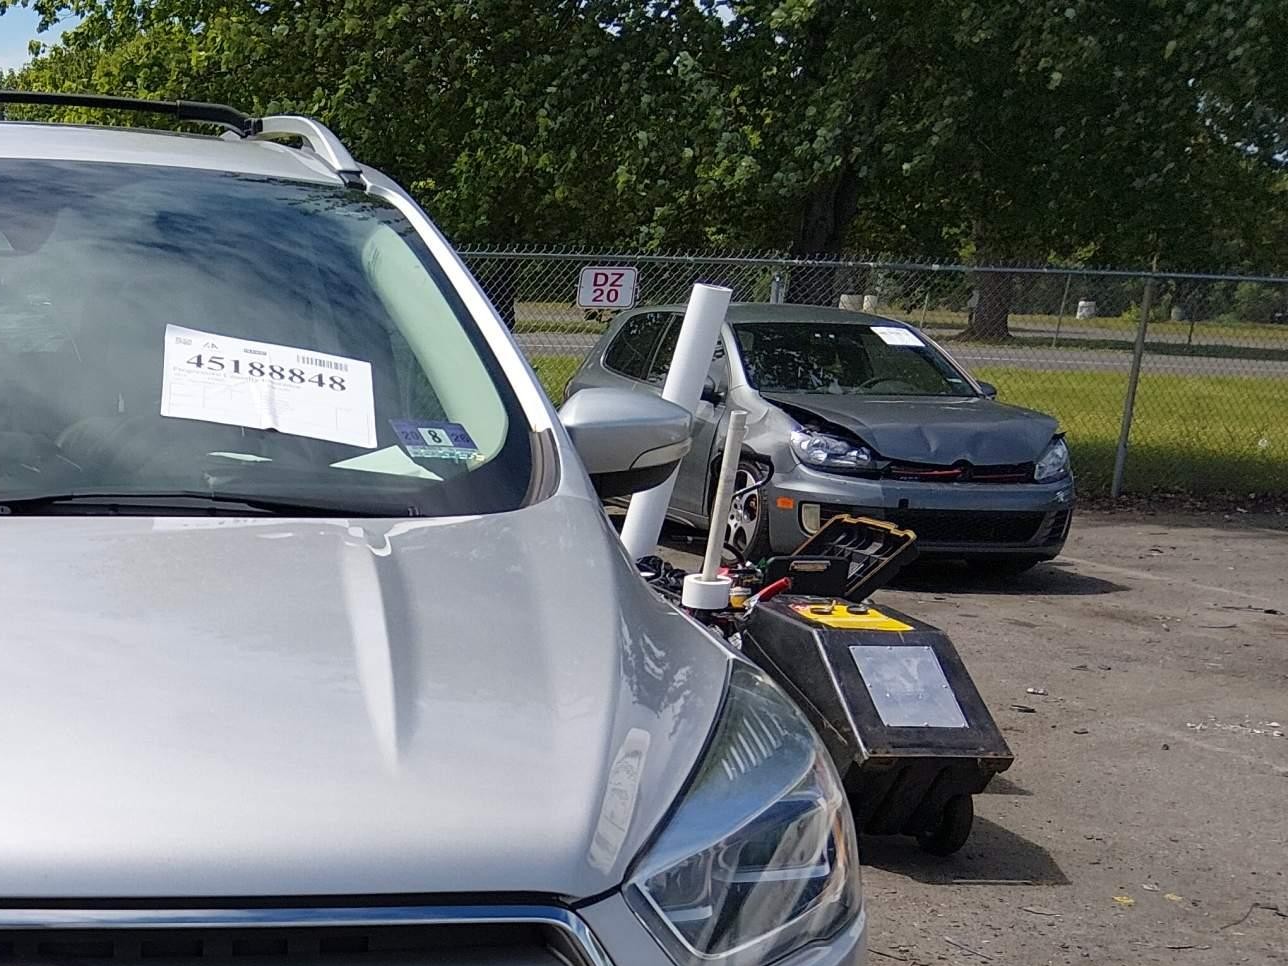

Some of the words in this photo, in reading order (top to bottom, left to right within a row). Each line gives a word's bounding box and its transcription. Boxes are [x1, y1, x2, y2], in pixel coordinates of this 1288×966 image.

[592, 272, 625, 287] DZ
[591, 288, 619, 303] 20
[185, 353, 347, 392] 45188848
[427, 429, 443, 444] 8
